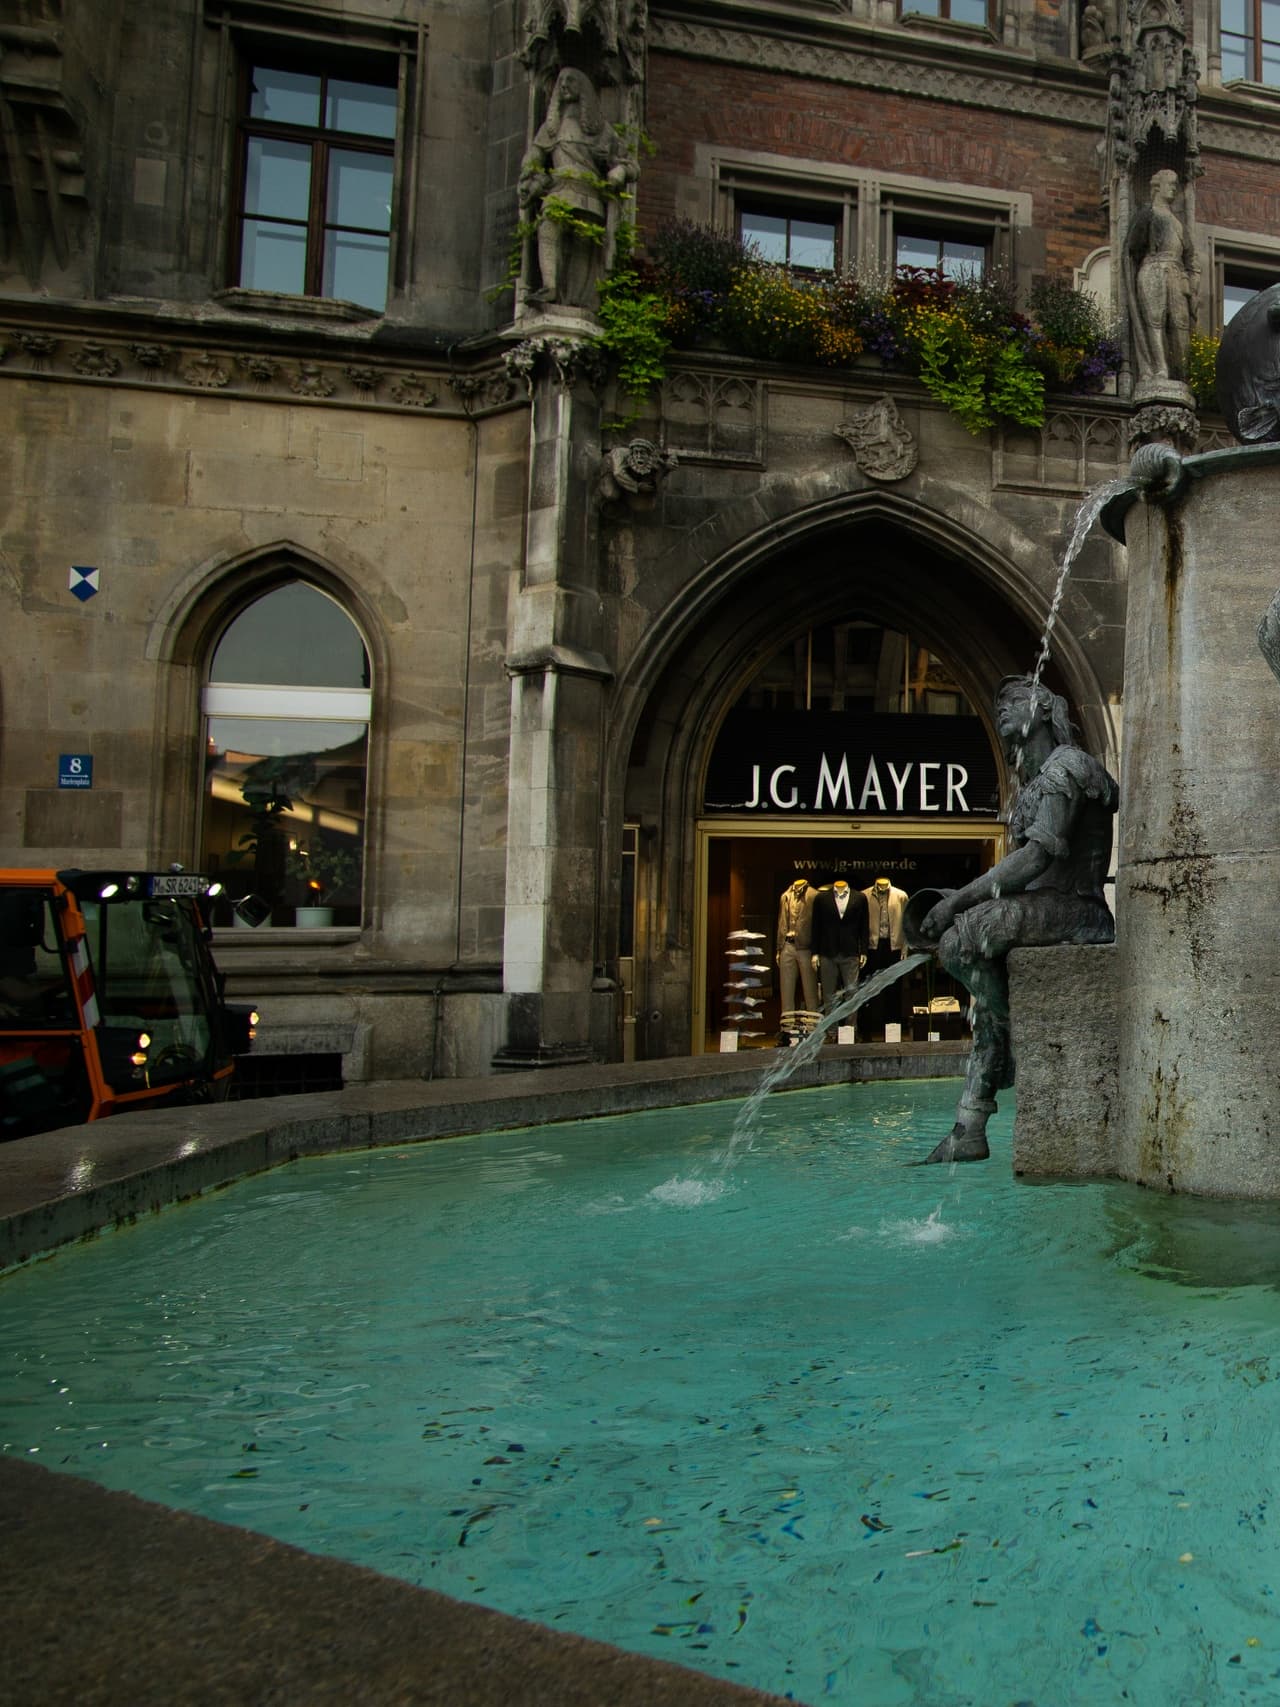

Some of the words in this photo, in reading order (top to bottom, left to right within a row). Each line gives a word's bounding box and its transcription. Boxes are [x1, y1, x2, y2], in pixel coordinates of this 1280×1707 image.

[70, 758, 81, 773] 8
[745, 764, 806, 809] J.G.
[814, 752, 970, 811] MAYER
[793, 858, 917, 873] www.jg-mayer.de
